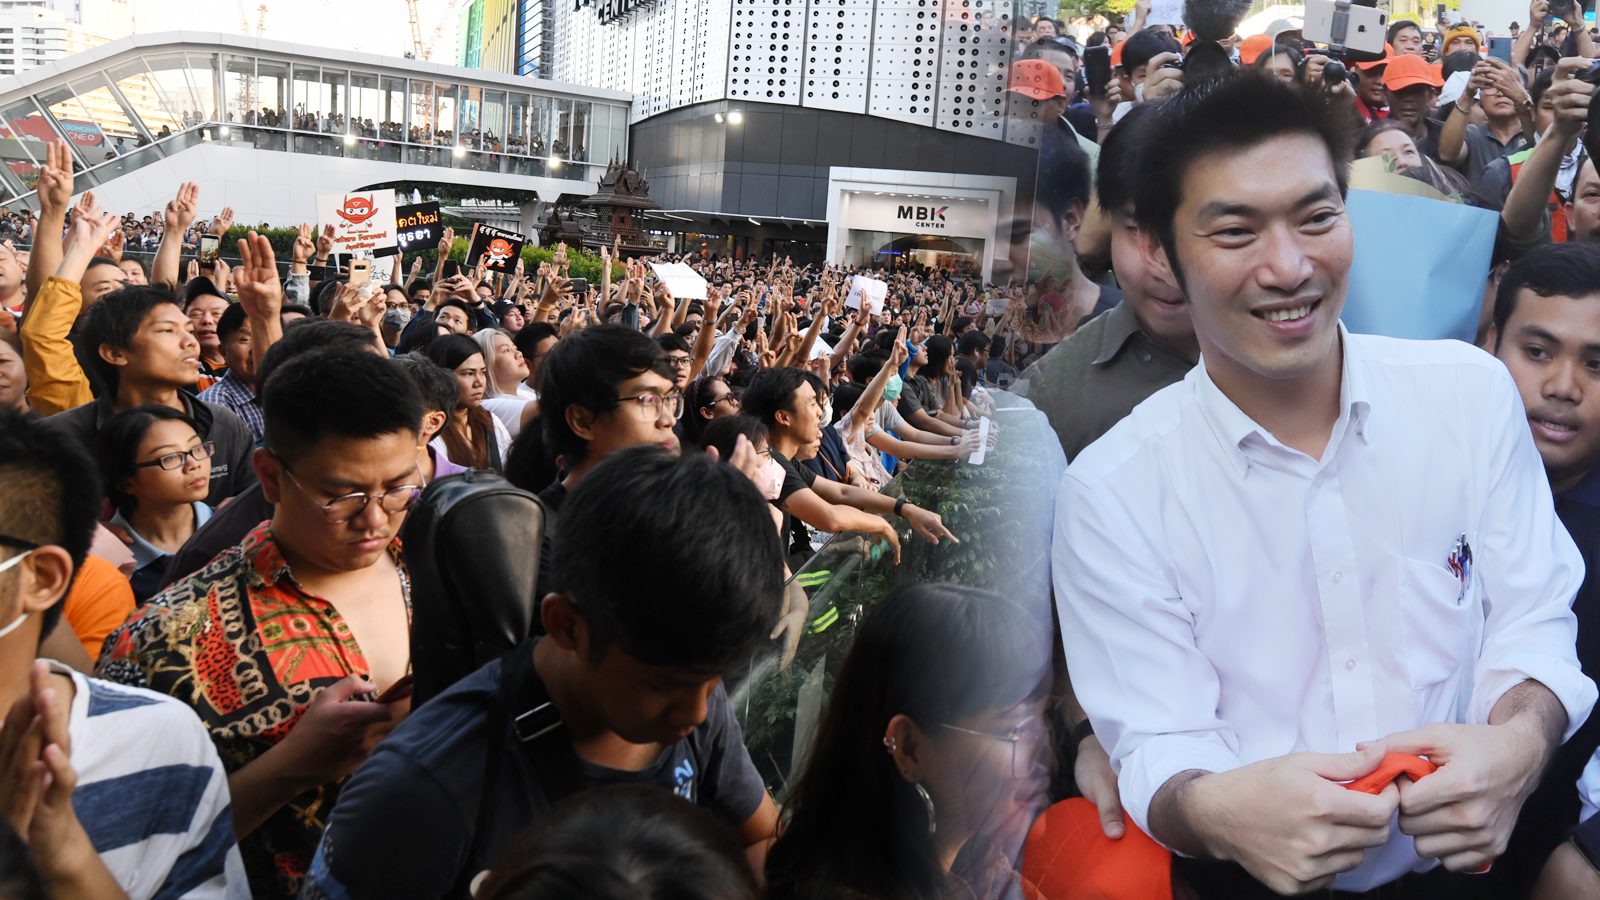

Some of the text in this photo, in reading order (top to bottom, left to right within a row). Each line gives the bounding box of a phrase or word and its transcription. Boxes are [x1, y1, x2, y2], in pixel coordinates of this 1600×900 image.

[396, 210, 438, 228] คตใหม่
[897, 205, 949, 221] MBK
[335, 230, 387, 243] uture Forward
